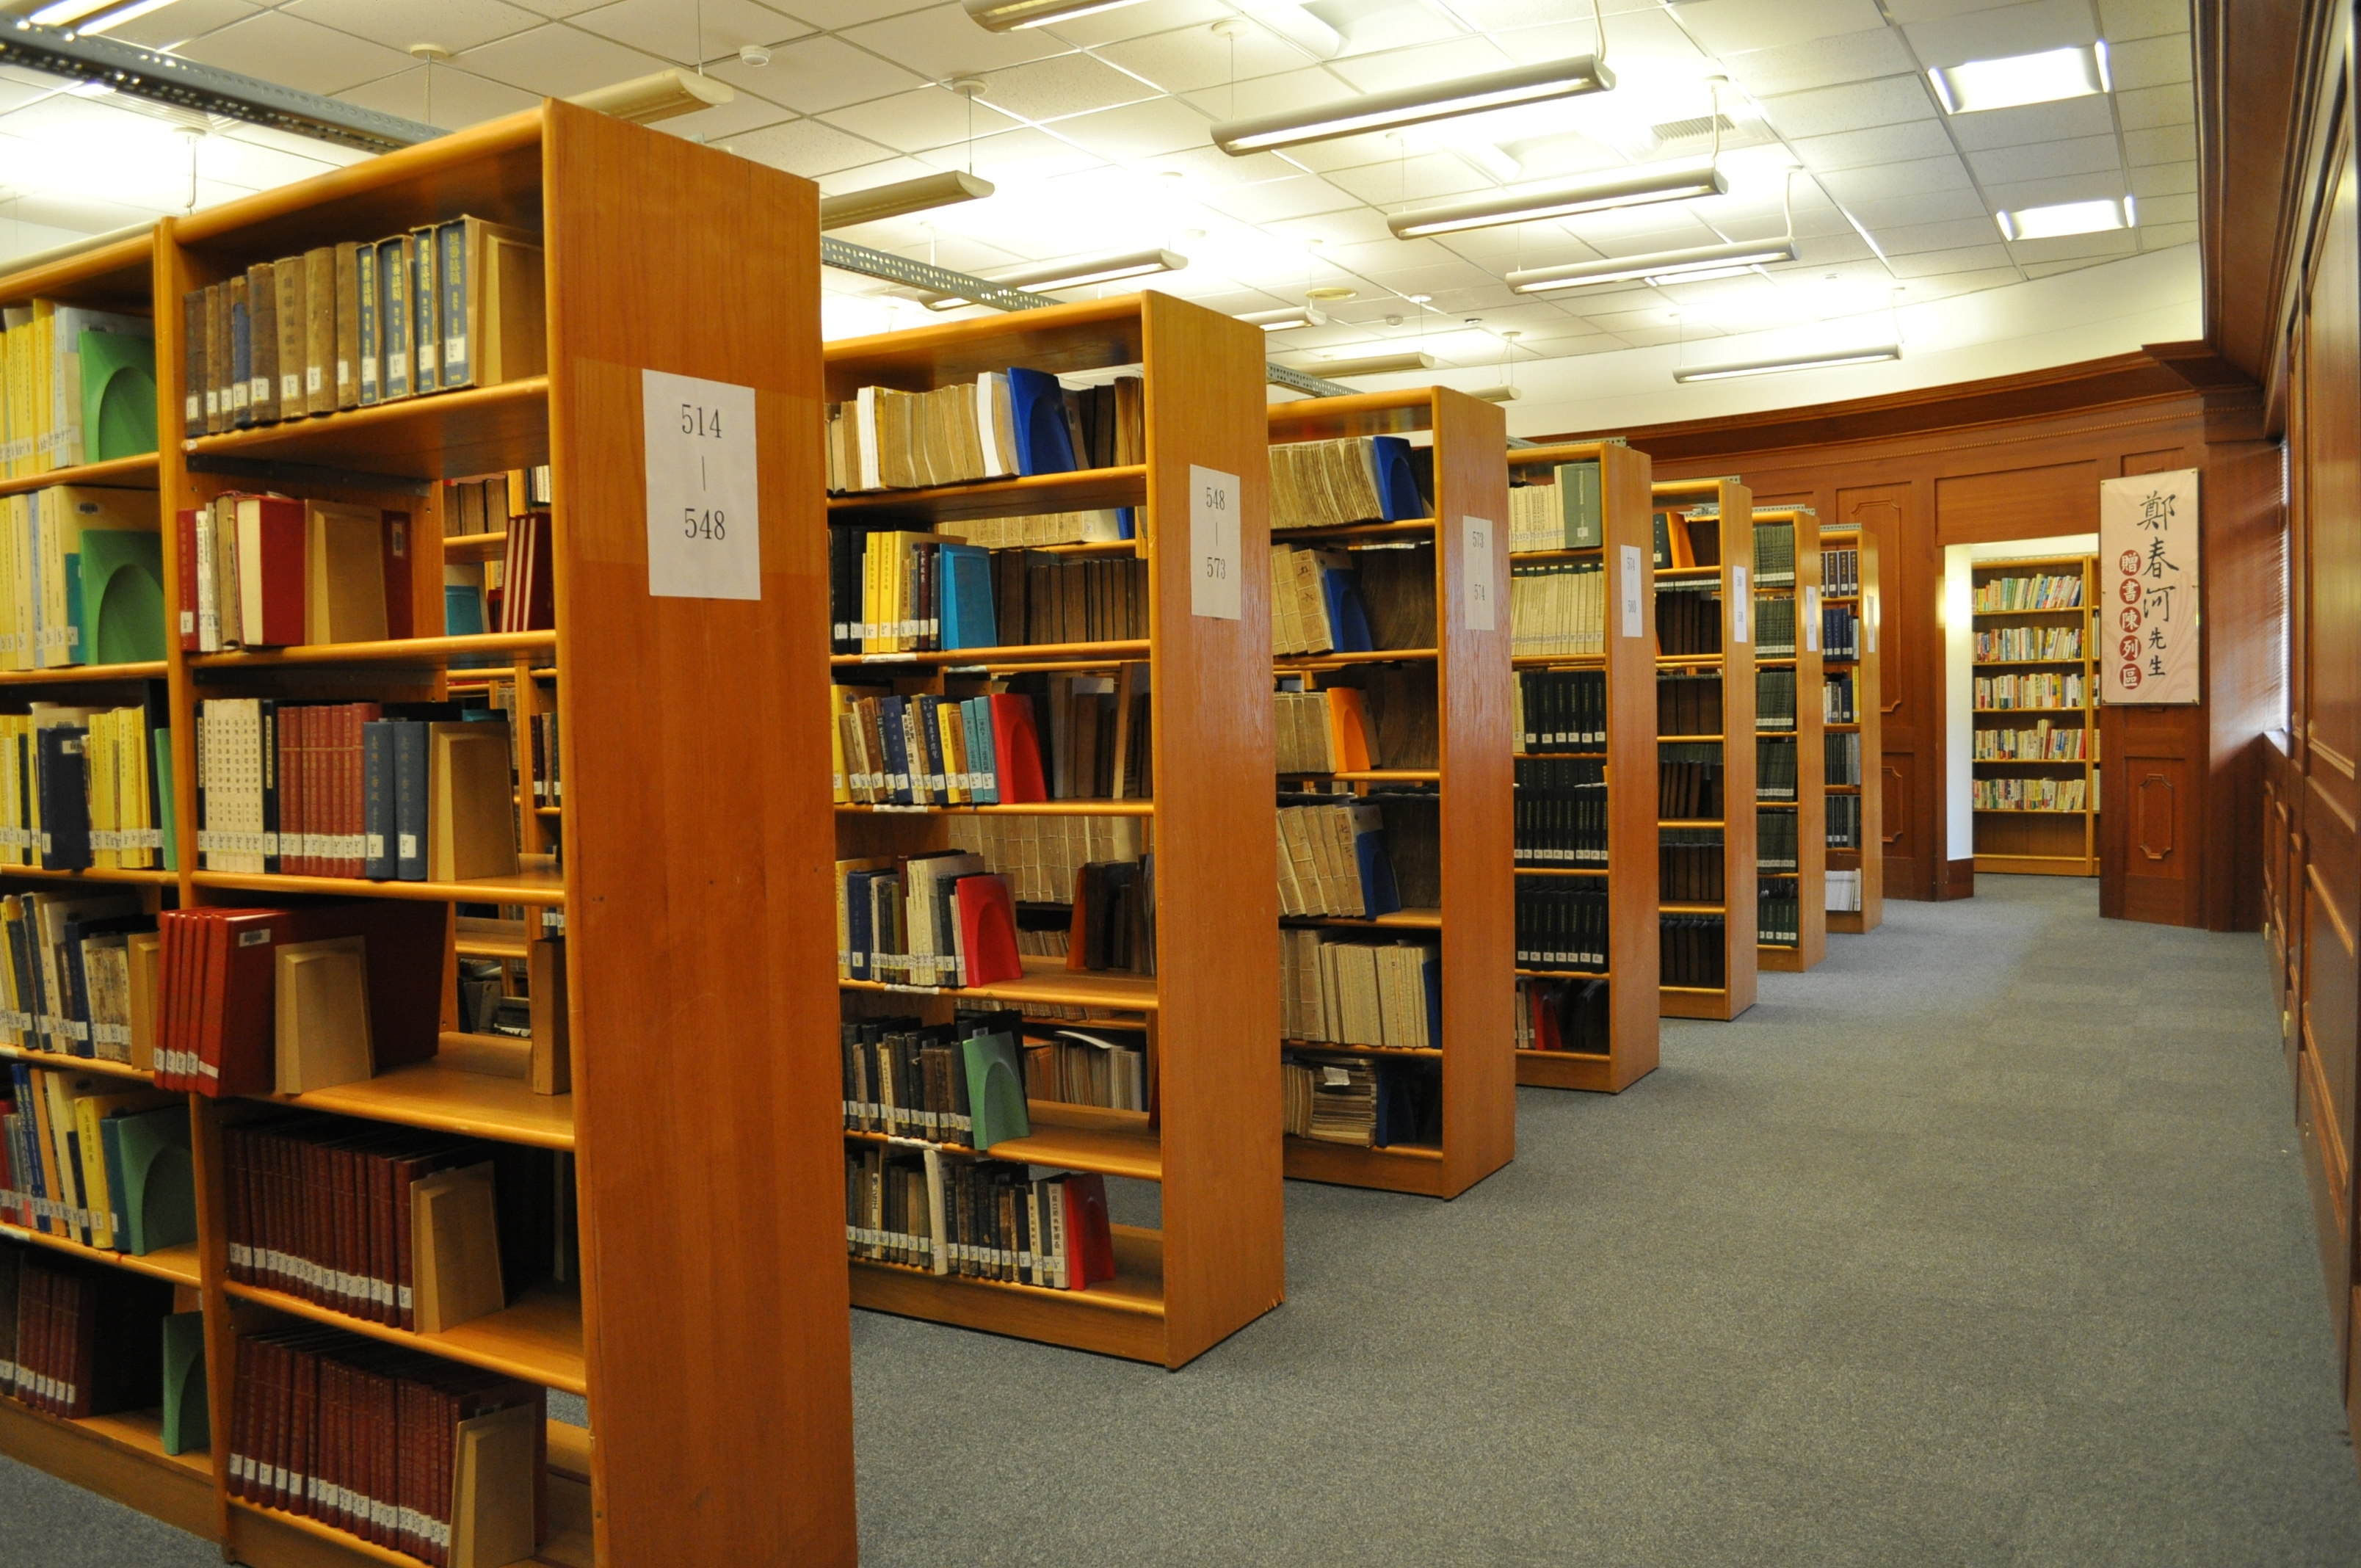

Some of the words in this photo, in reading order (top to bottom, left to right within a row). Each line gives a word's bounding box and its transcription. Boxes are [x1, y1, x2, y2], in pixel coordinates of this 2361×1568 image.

[681, 403, 722, 438] 514
[1205, 487, 1225, 511] 548
[684, 507, 726, 541] 548
[1473, 531, 1484, 548] 573
[1207, 556, 1226, 580] 573
[1474, 584, 1485, 601] 574
[2136, 490, 2180, 677] 鄭春河先生
[2120, 551, 2140, 689] 贈書陳列區
